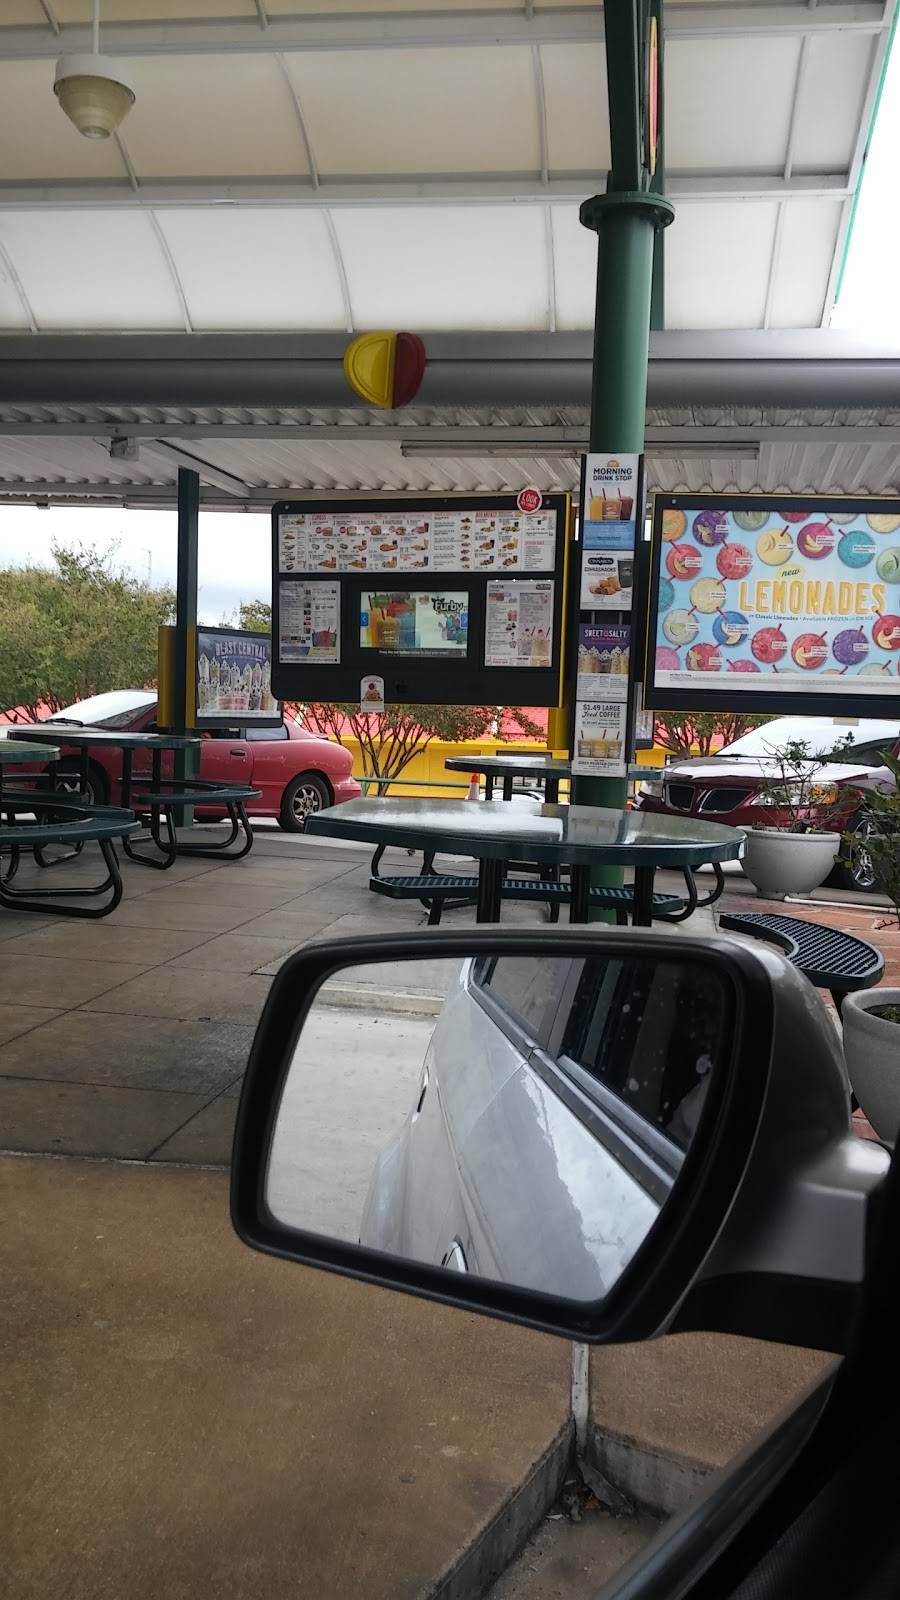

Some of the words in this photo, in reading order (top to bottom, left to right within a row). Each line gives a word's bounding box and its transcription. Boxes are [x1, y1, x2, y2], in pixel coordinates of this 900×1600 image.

[593, 467, 633, 475] MORNING
[521, 492, 538, 504] LOOK
[781, 568, 800, 577] new
[739, 579, 887, 615] LEMONADES
[433, 599, 464, 613] Furby
[584, 629, 604, 637] SWEET
[608, 630, 628, 638] SALTY
[215, 641, 237, 656] BLAST
[239, 640, 266, 659] CENTRAL
